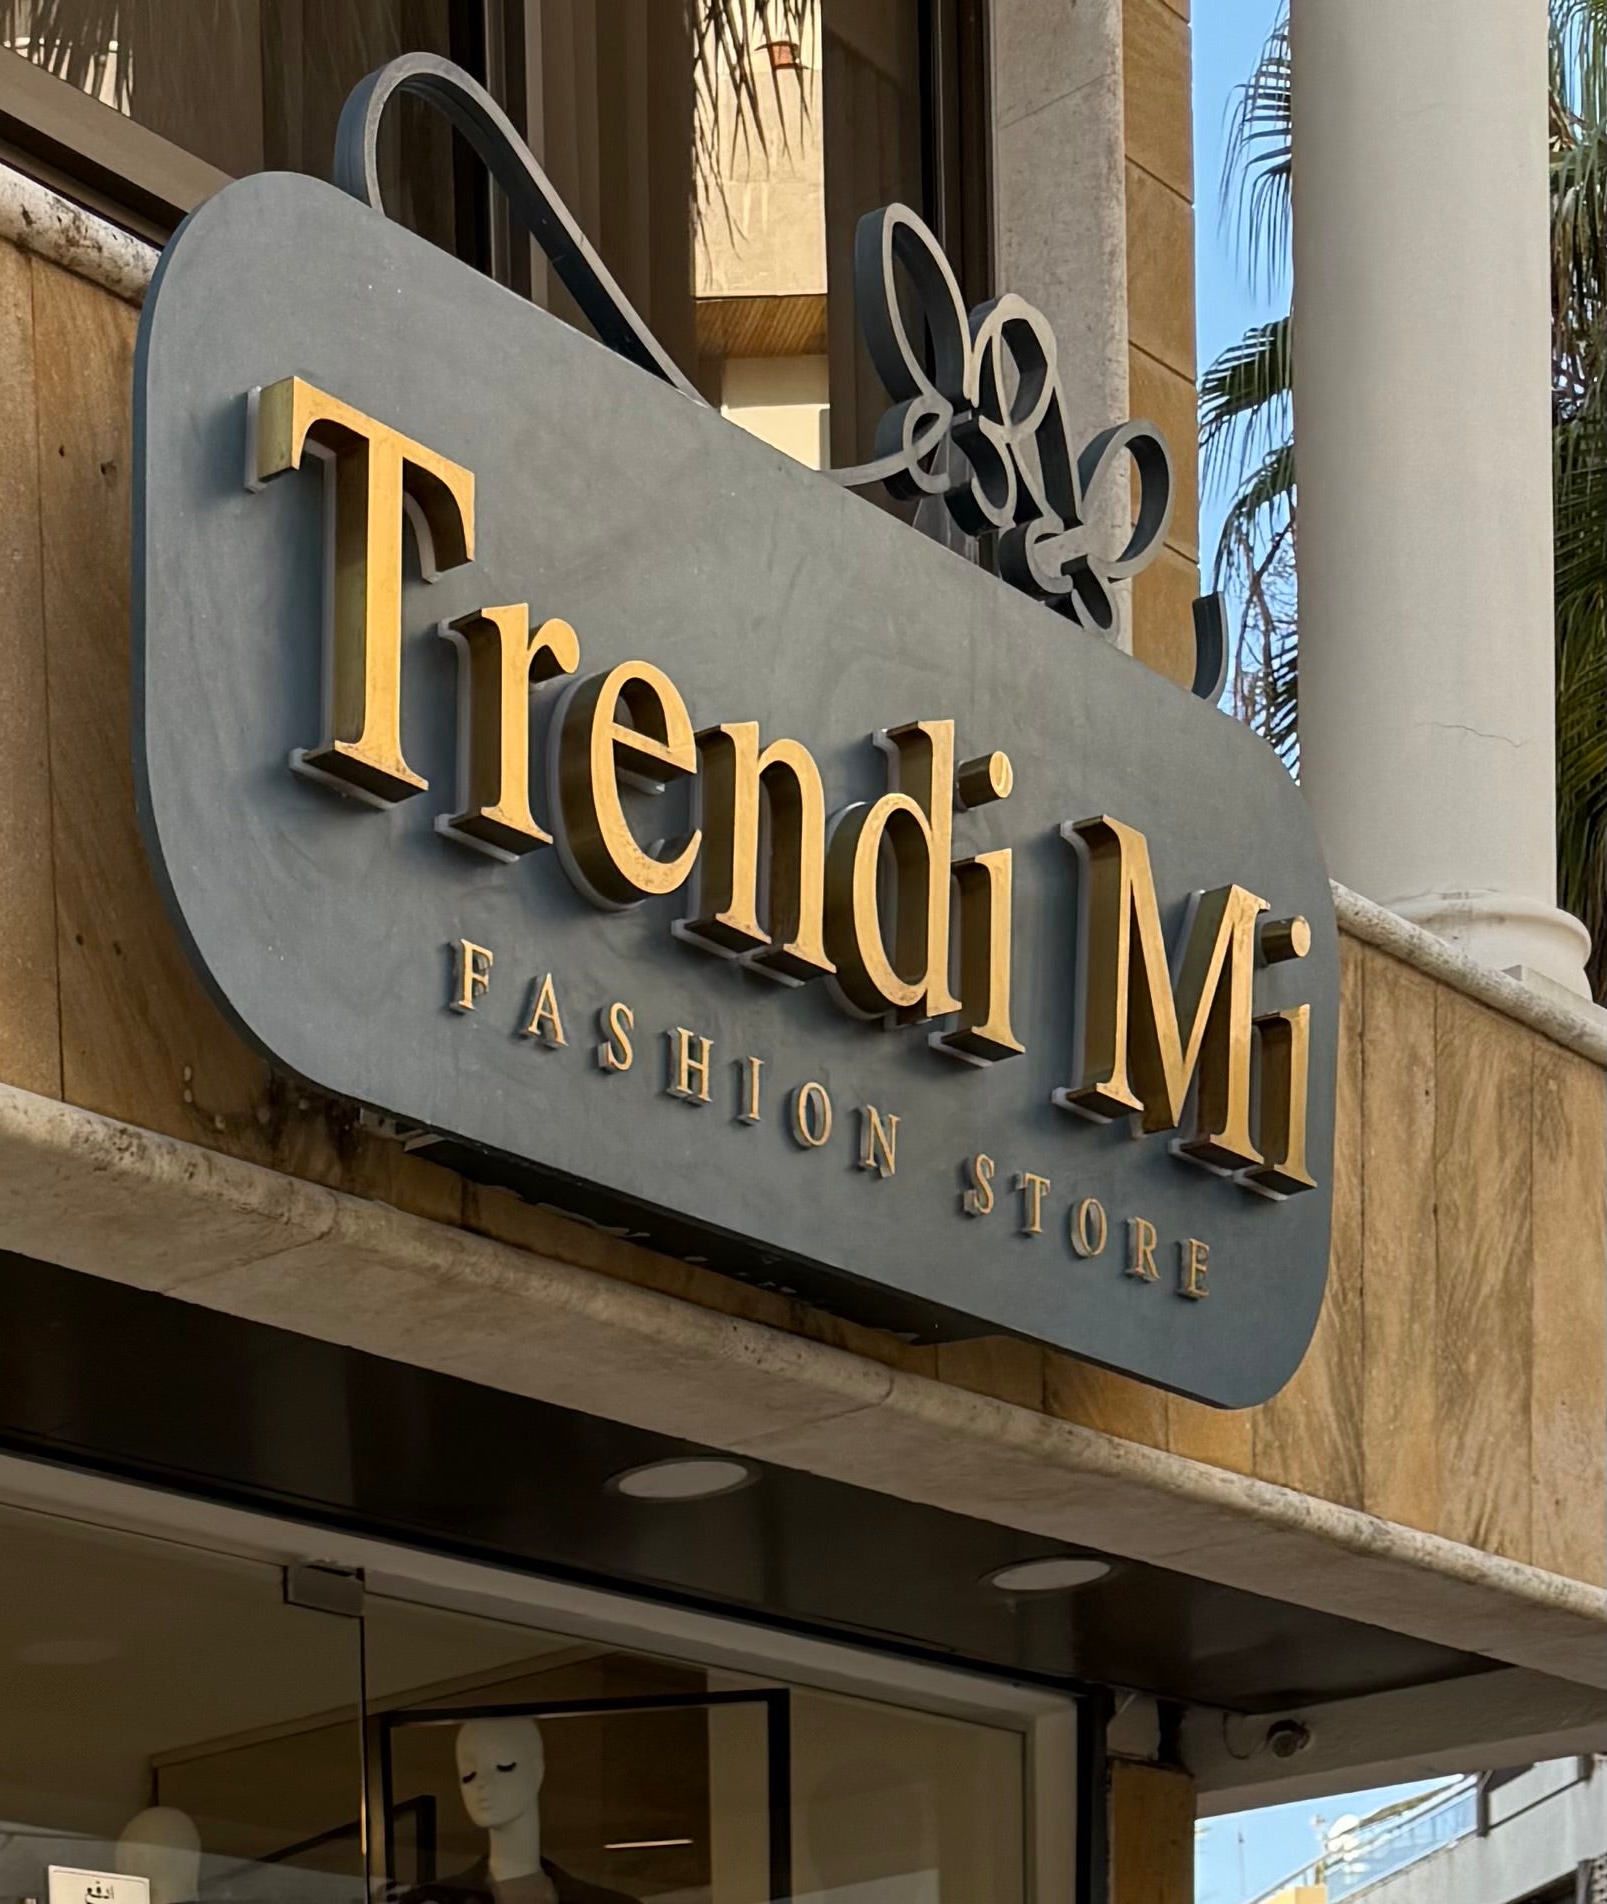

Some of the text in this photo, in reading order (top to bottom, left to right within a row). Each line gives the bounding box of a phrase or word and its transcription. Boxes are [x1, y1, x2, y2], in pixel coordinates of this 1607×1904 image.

[251, 375, 1318, 1192] Trendi Mi
[451, 937, 1210, 1298] FASHION STORE
